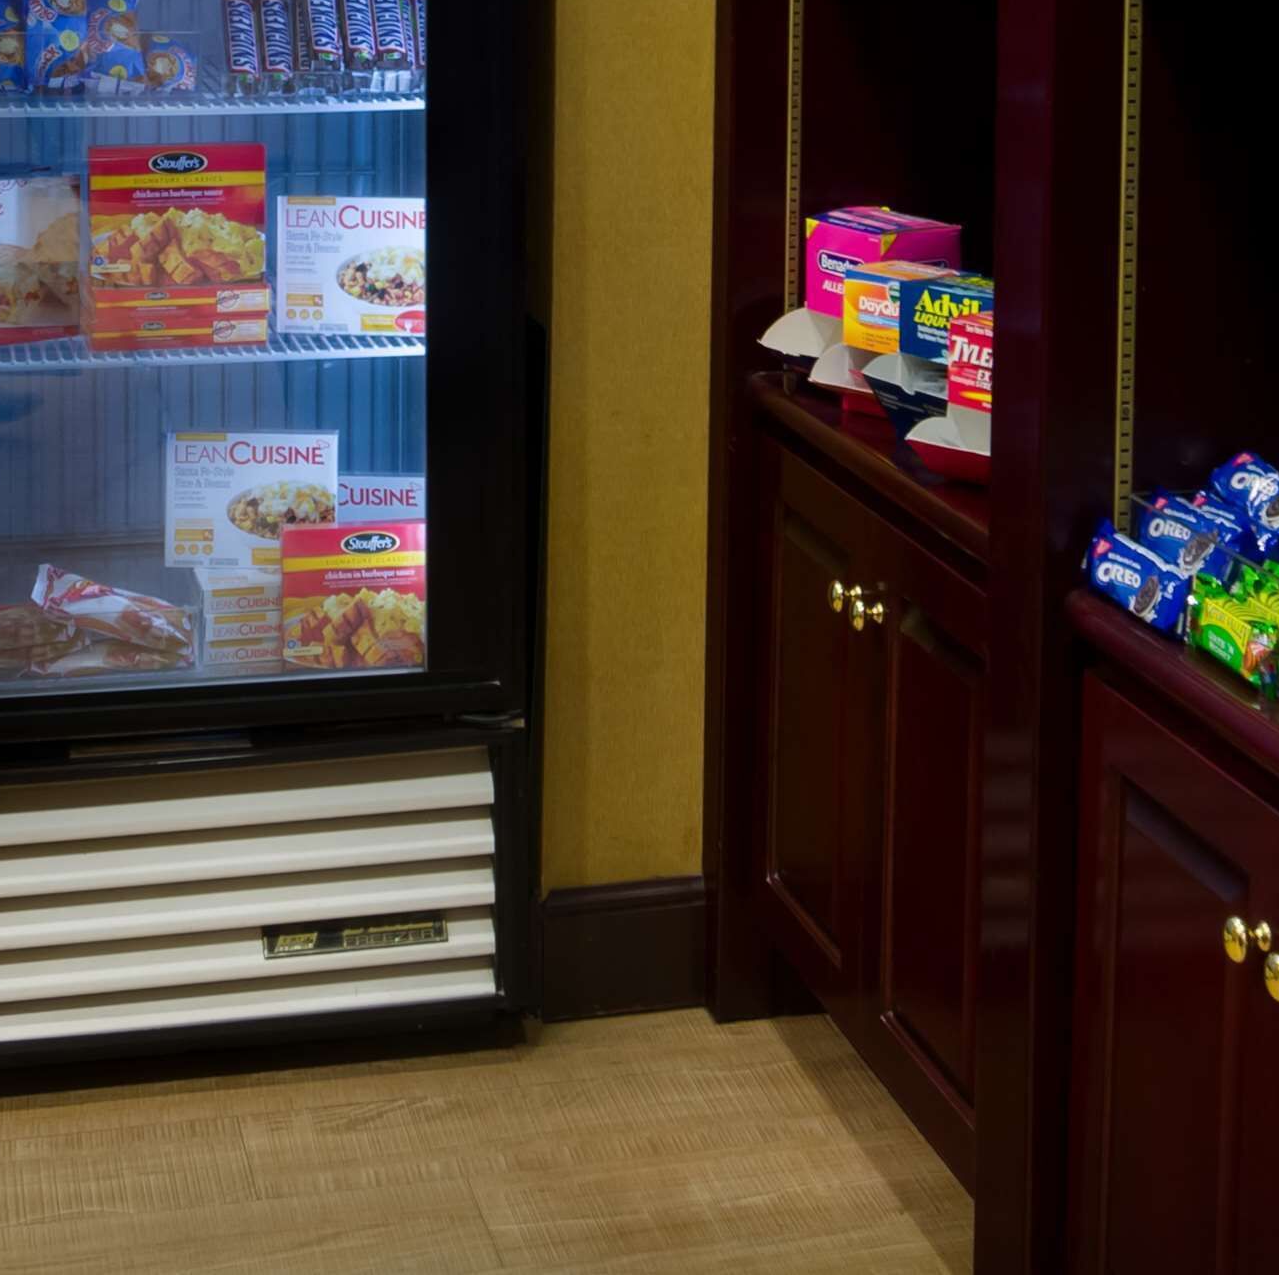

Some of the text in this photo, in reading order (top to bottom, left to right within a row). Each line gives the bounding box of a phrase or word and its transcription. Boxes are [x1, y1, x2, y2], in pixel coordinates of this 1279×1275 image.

[286, 208, 337, 228] LEAN
[914, 288, 982, 319] Advil
[174, 441, 325, 465] LEAN CUISINE
[338, 483, 418, 507] CUISINE
[1147, 516, 1192, 541] OREO
[348, 535, 393, 551] Stouffer's
[1096, 561, 1142, 589] OREO
